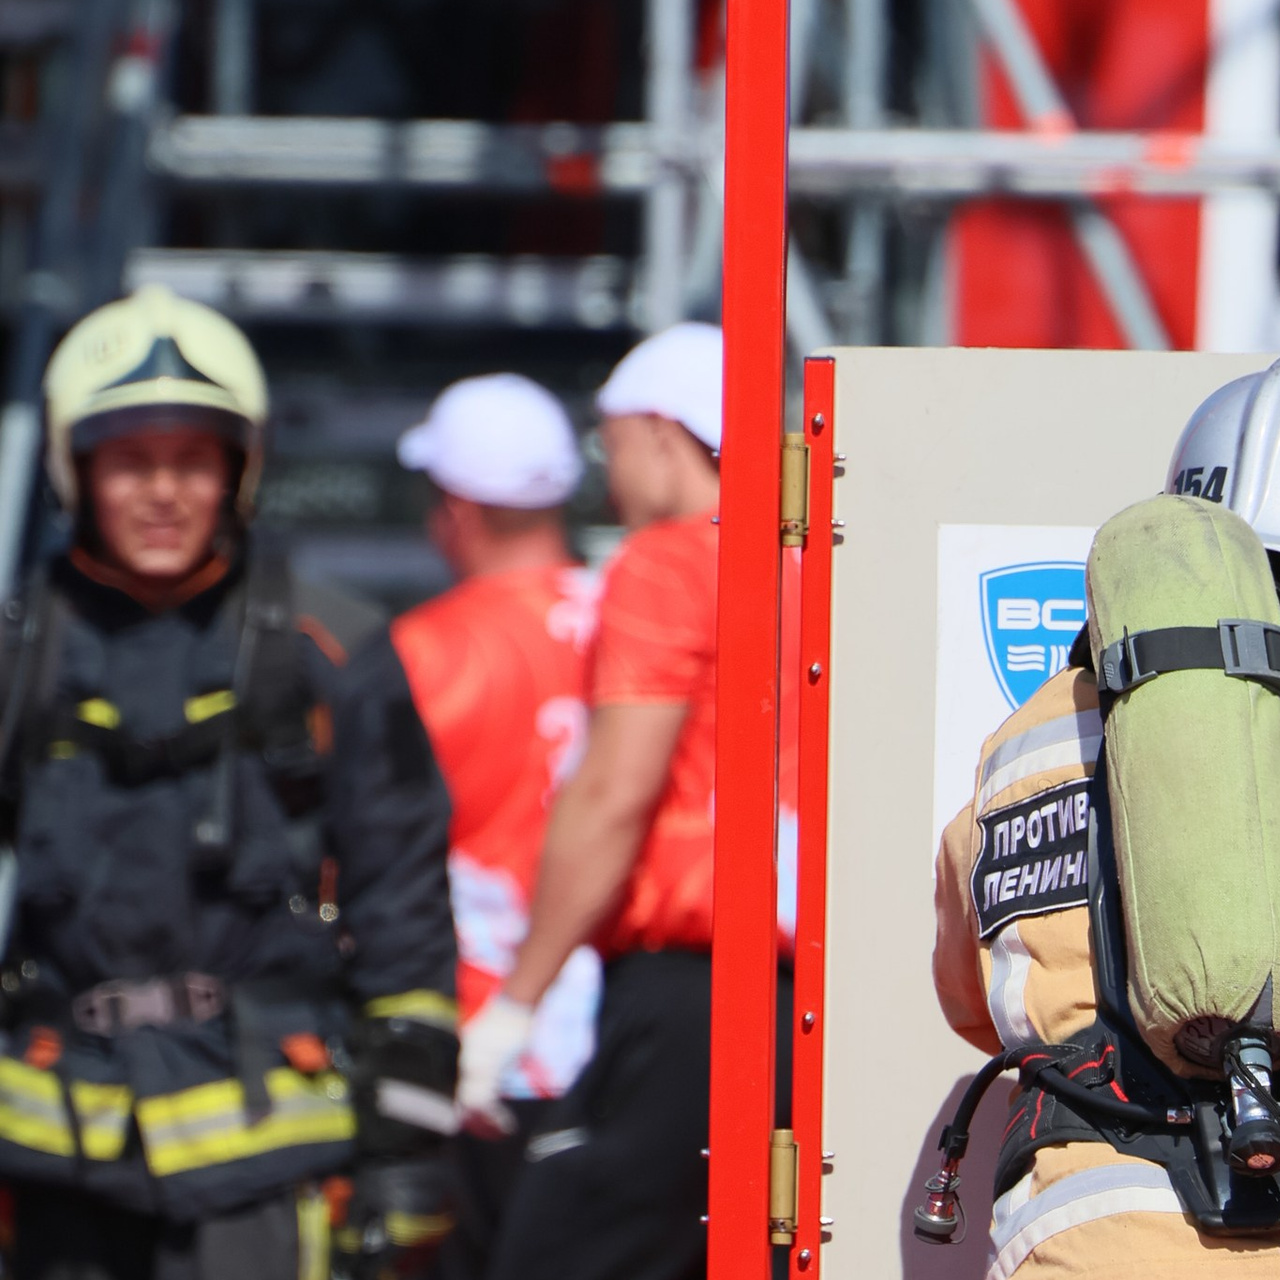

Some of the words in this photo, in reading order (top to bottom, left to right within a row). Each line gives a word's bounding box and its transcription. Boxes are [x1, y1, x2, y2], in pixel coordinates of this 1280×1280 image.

[1173, 466, 1228, 504] 154
[997, 598, 1090, 631] ВС
[992, 791, 1089, 861] ПРОТИВ
[983, 850, 1089, 912] ЛЕНИН
